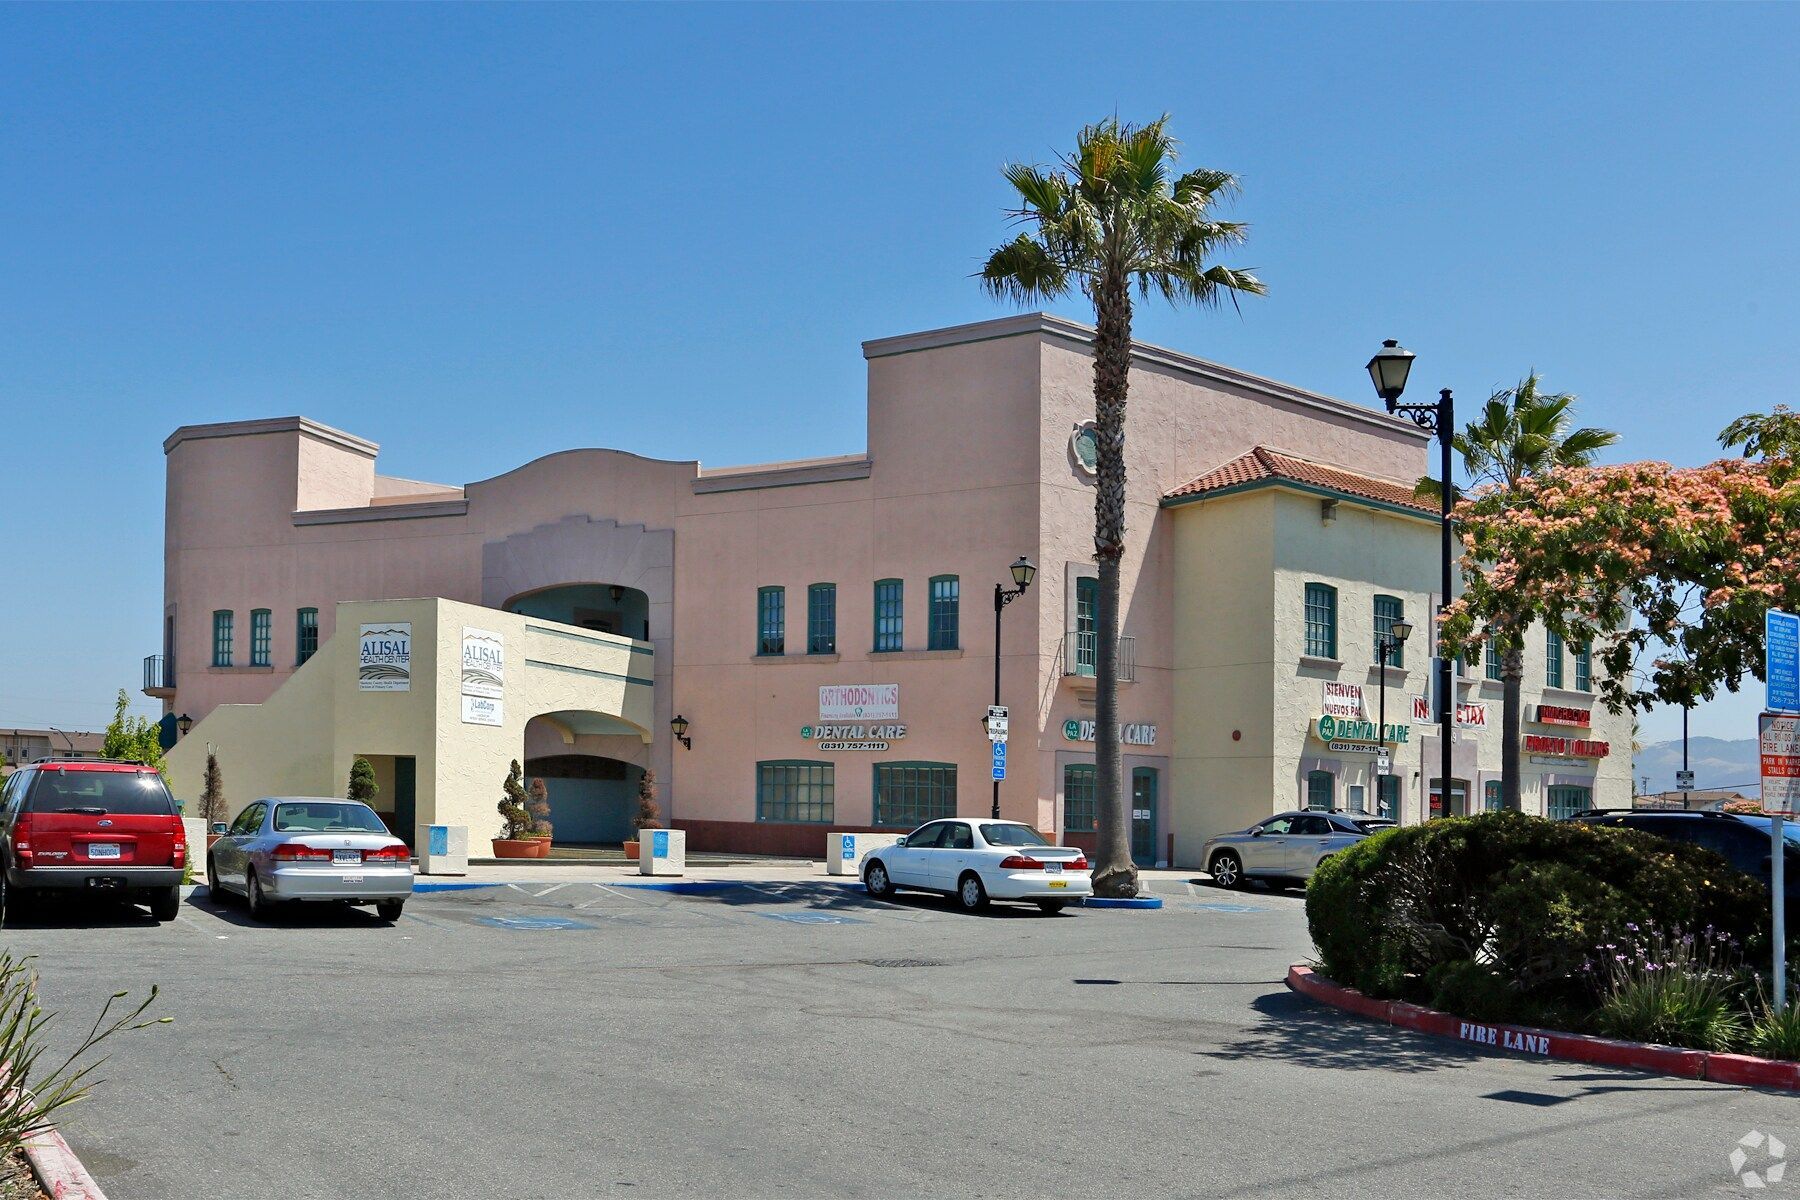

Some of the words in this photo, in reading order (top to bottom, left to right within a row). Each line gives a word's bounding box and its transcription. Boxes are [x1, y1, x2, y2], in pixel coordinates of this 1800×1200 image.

[361, 641, 409, 655] ALISAL
[464, 645, 502, 664] ALISAL
[464, 659, 482, 668] HEALTH
[483, 661, 502, 671] CENTER
[475, 699, 494, 711] LabCorp
[1324, 704, 1349, 715] NUEVOS
[1465, 705, 1485, 725] TAX
[814, 725, 865, 739] DENTAL
[869, 725, 906, 739] CARE
[1127, 724, 1156, 745] CARE
[1322, 728, 1332, 736] PAZ
[1338, 720, 1378, 740] DENTAL
[1384, 724, 1410, 743] CARE
[1763, 732, 1771, 741] ALL
[820, 742, 844, 750] (831)
[847, 742, 885, 750] 757-1111
[1331, 743, 1350, 751] (831)
[1525, 736, 1566, 754] PRONTO
[1763, 743, 1777, 753] FIRE
[1781, 744, 1800, 754] LANE
[1763, 757, 1775, 766] PARK
[1768, 766, 1785, 775] STALLS
[1787, 767, 1799, 775] ONLY
[1460, 1022, 1497, 1045] FIRE
[1503, 1030, 1550, 1055] LANE
